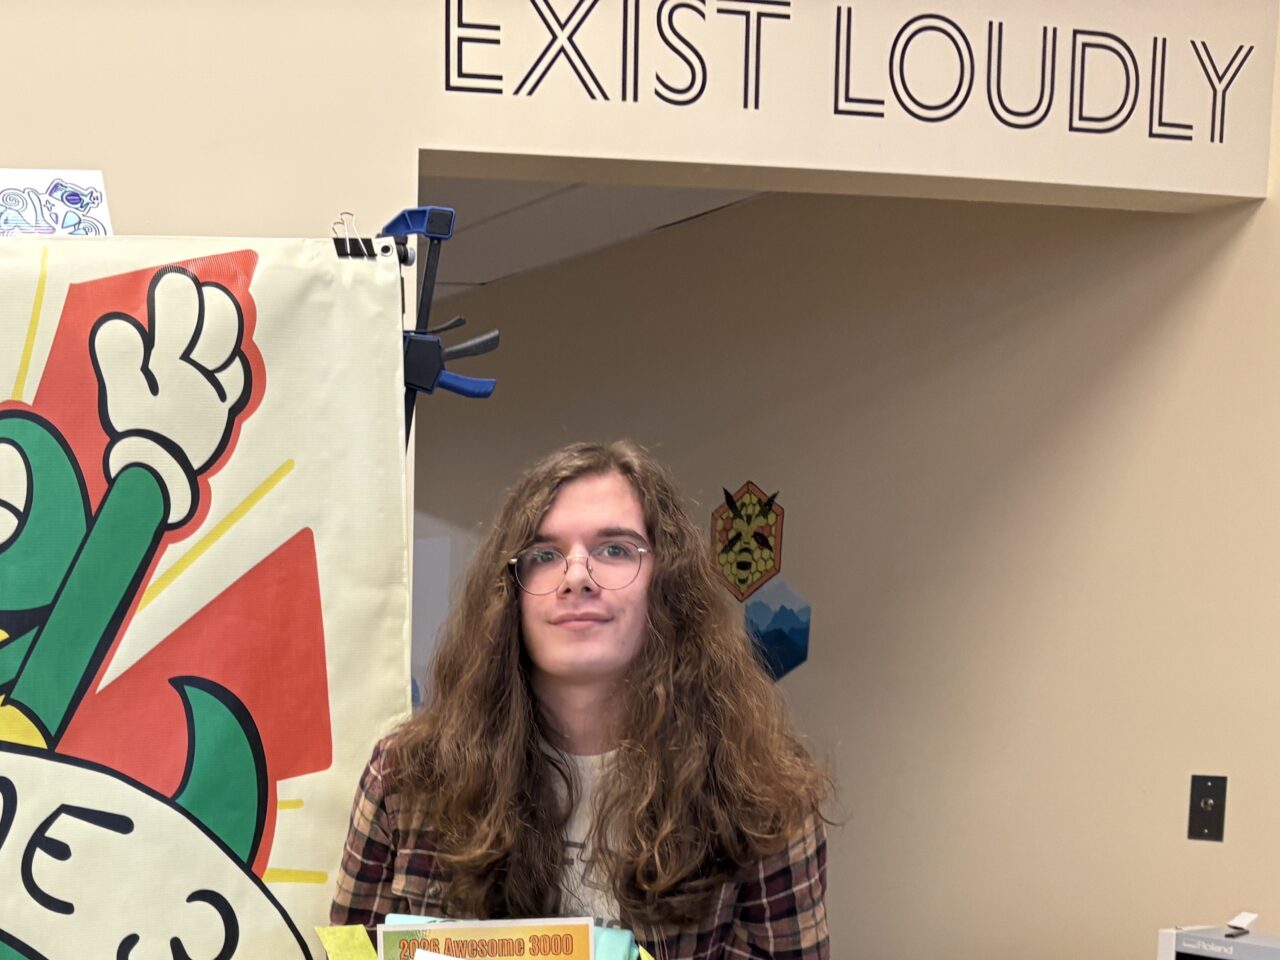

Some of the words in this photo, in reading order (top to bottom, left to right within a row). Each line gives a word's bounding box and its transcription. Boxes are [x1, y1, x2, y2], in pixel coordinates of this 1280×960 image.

[445, 0, 791, 110] EXIST
[832, 6, 1255, 144] LOUDLY
[443, 936, 525, 958] Awesome
[529, 933, 574, 957] 3000
